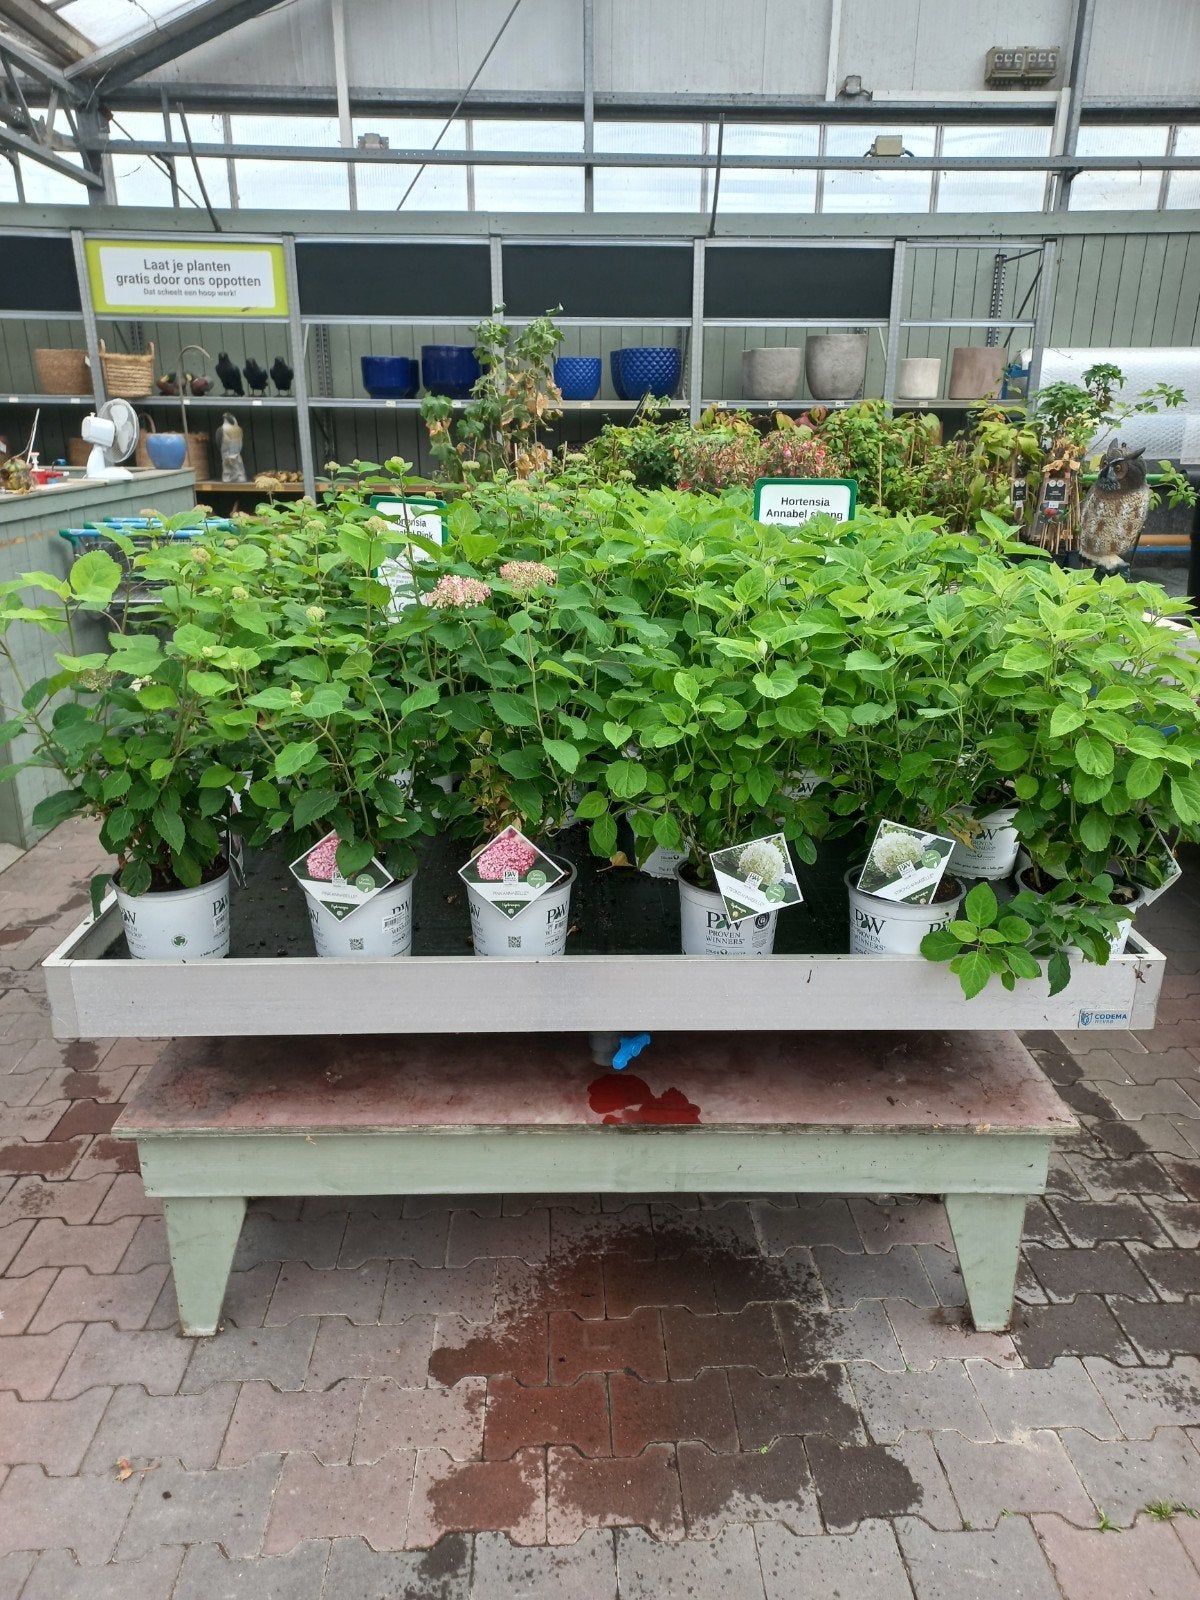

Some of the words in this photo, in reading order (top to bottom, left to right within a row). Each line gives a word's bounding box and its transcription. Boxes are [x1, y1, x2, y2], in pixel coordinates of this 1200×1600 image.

[143, 258, 170, 271] Laat
[172, 259, 184, 274] je
[187, 260, 231, 273] planten
[116, 273, 150, 287] gratis
[153, 273, 180, 285] door
[184, 275, 205, 286] ons
[208, 275, 261, 287] oppotten
[143, 287, 156, 296] Dat
[157, 288, 183, 296] scheelt
[198, 289, 216, 298] hoop
[781, 496, 830, 507] Hortensia
[766, 508, 808, 519] Annabel
[854, 907, 887, 936] PW
[708, 929, 741, 938] PROVEN
